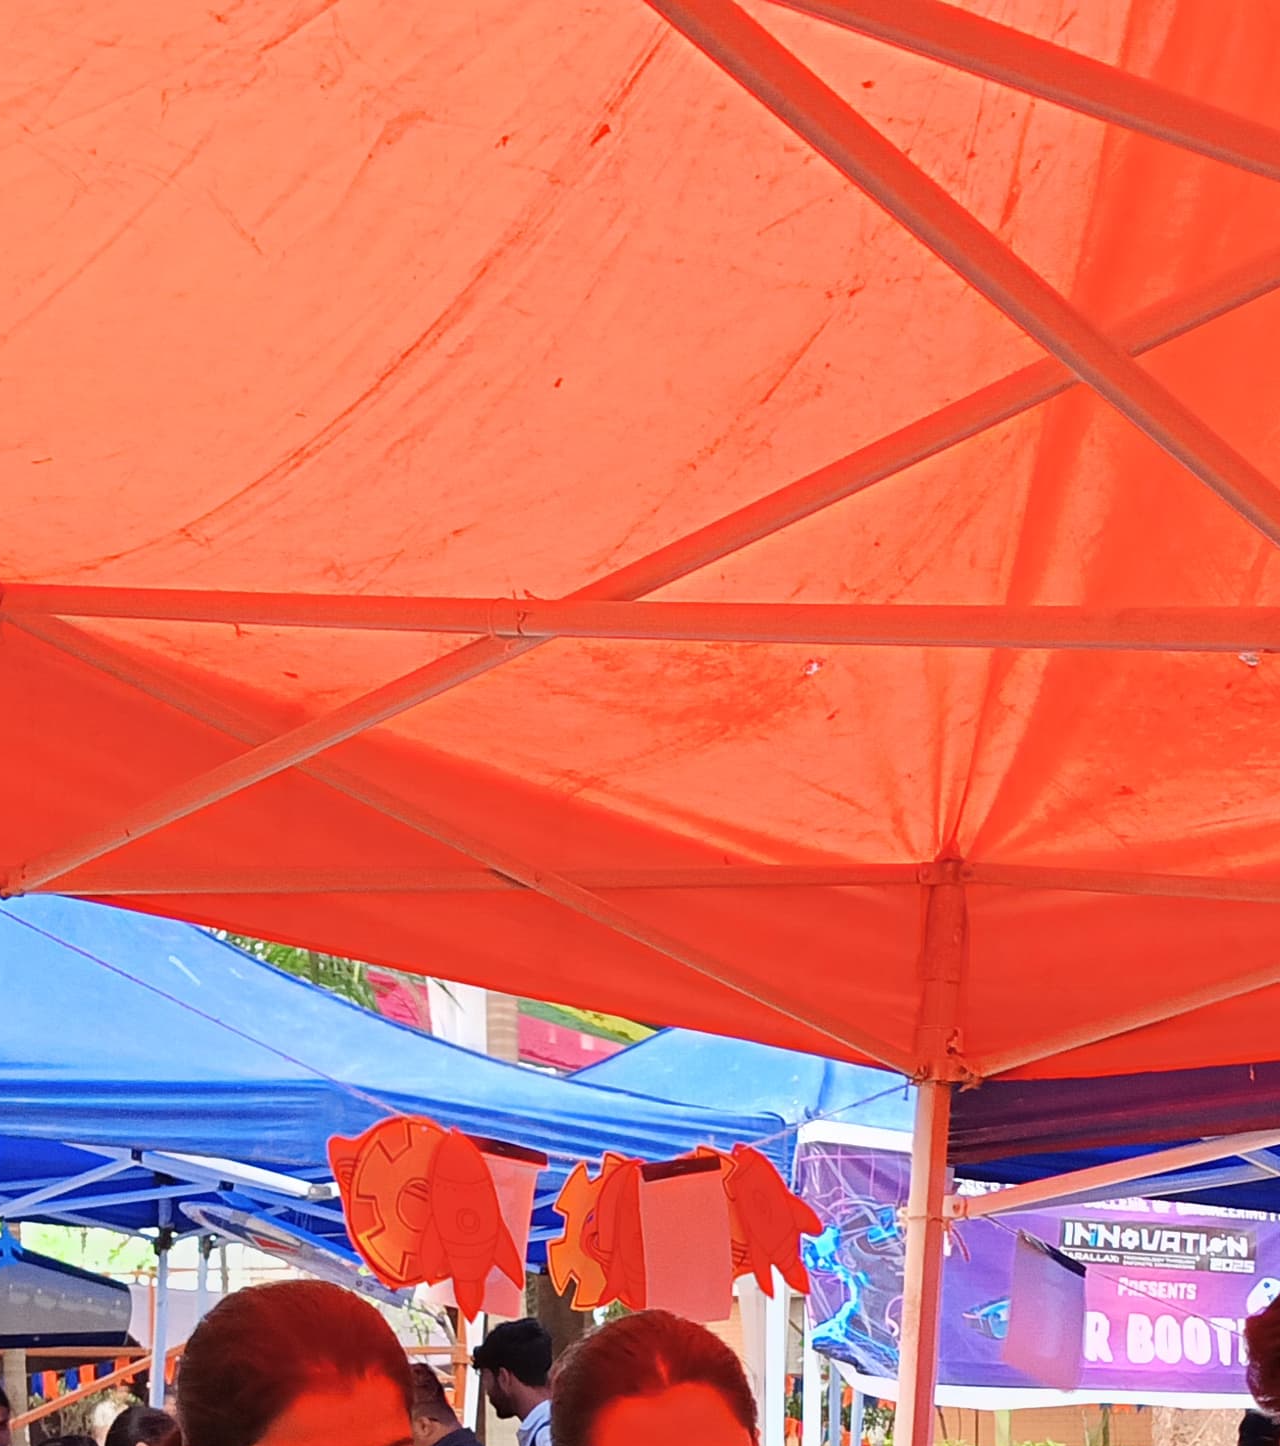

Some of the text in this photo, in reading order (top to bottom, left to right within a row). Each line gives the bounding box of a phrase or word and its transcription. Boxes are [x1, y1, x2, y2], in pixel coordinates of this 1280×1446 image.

[1063, 1221, 1249, 1258] INNOVATION
[1210, 1257, 1255, 1274] 2025
[1117, 1277, 1197, 1300] PRESENTS
[1083, 1311, 1114, 1363] R
